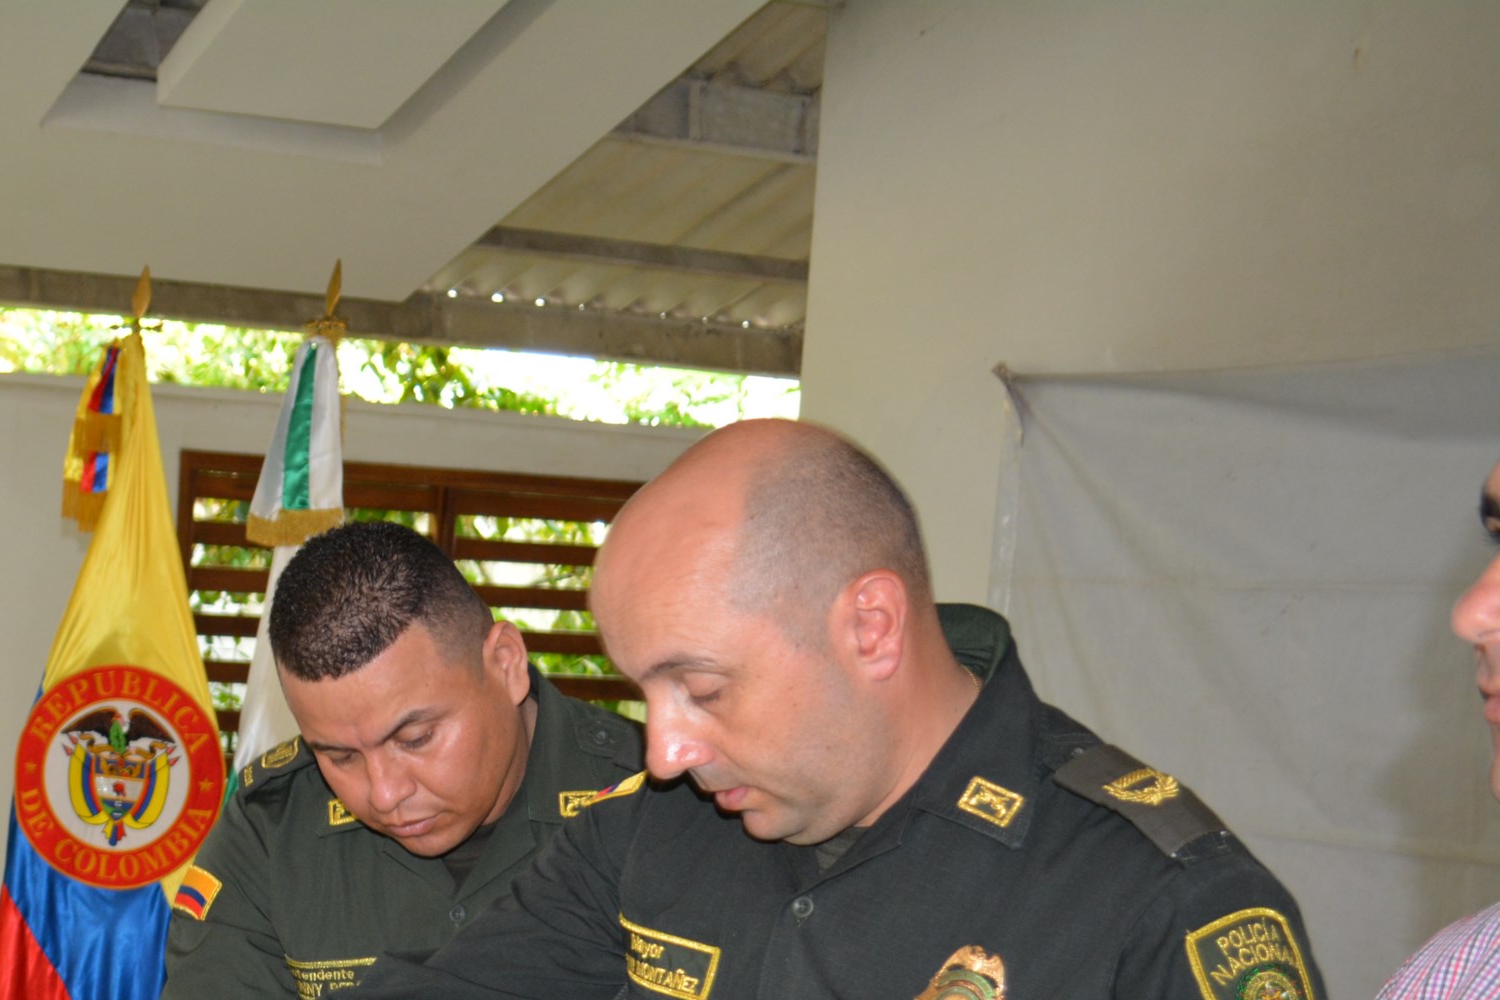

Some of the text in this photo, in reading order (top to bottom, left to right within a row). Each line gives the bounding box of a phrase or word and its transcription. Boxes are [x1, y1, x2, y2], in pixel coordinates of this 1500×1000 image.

[31, 670, 208, 752] REPUBLICA
[21, 788, 213, 882] DE COLOMBIA
[1210, 942, 1299, 986] NACIONAL
